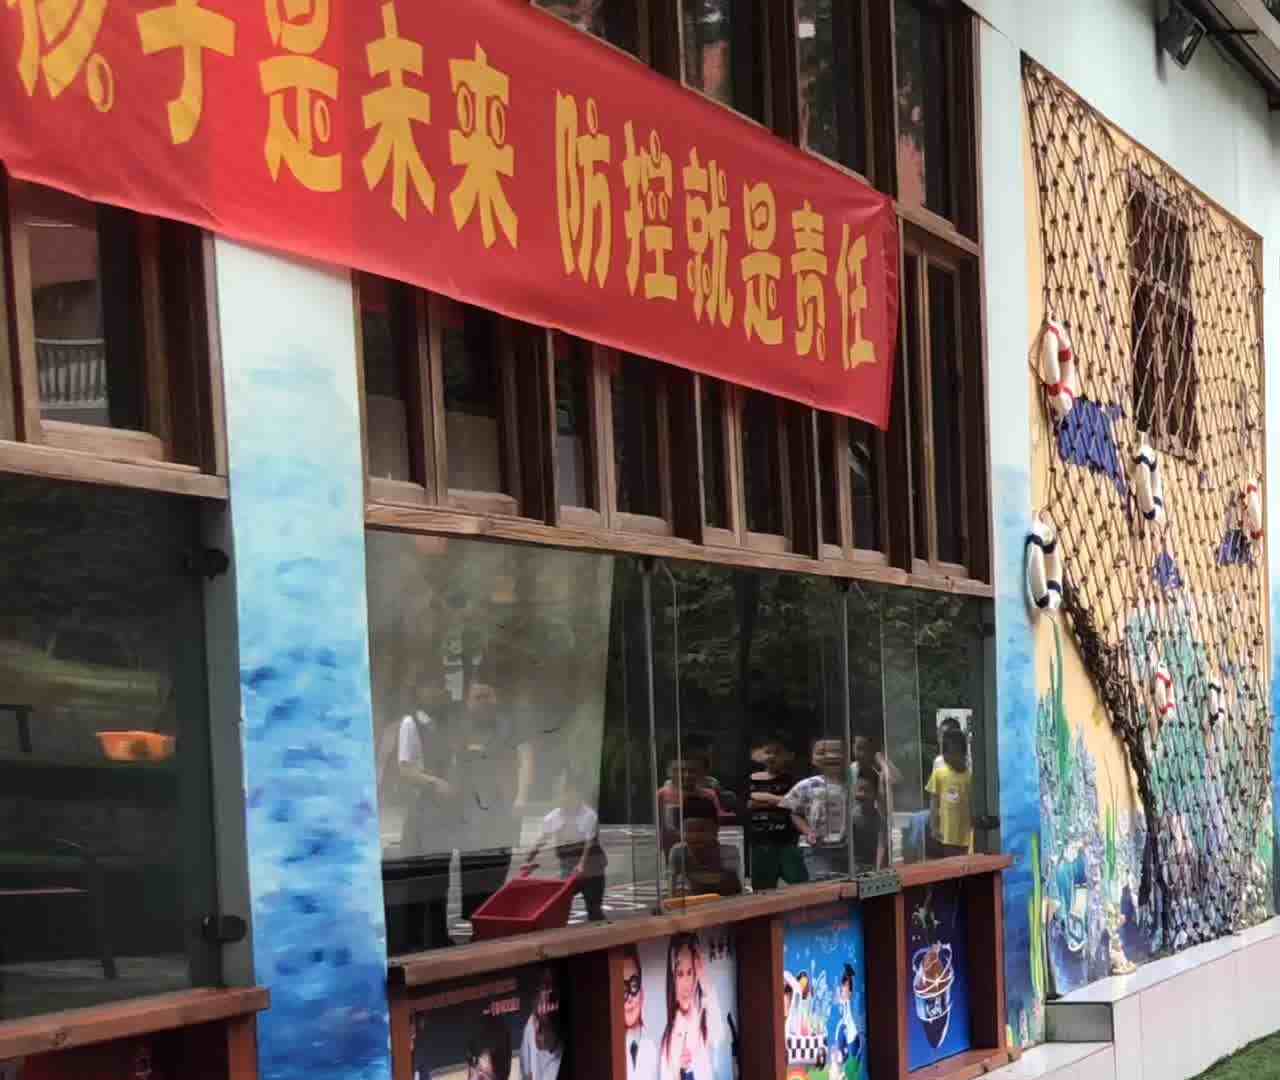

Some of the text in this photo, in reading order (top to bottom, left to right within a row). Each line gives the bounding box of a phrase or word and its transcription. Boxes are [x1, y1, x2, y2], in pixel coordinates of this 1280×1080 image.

[554, 88, 877, 371] 防控就是责任
